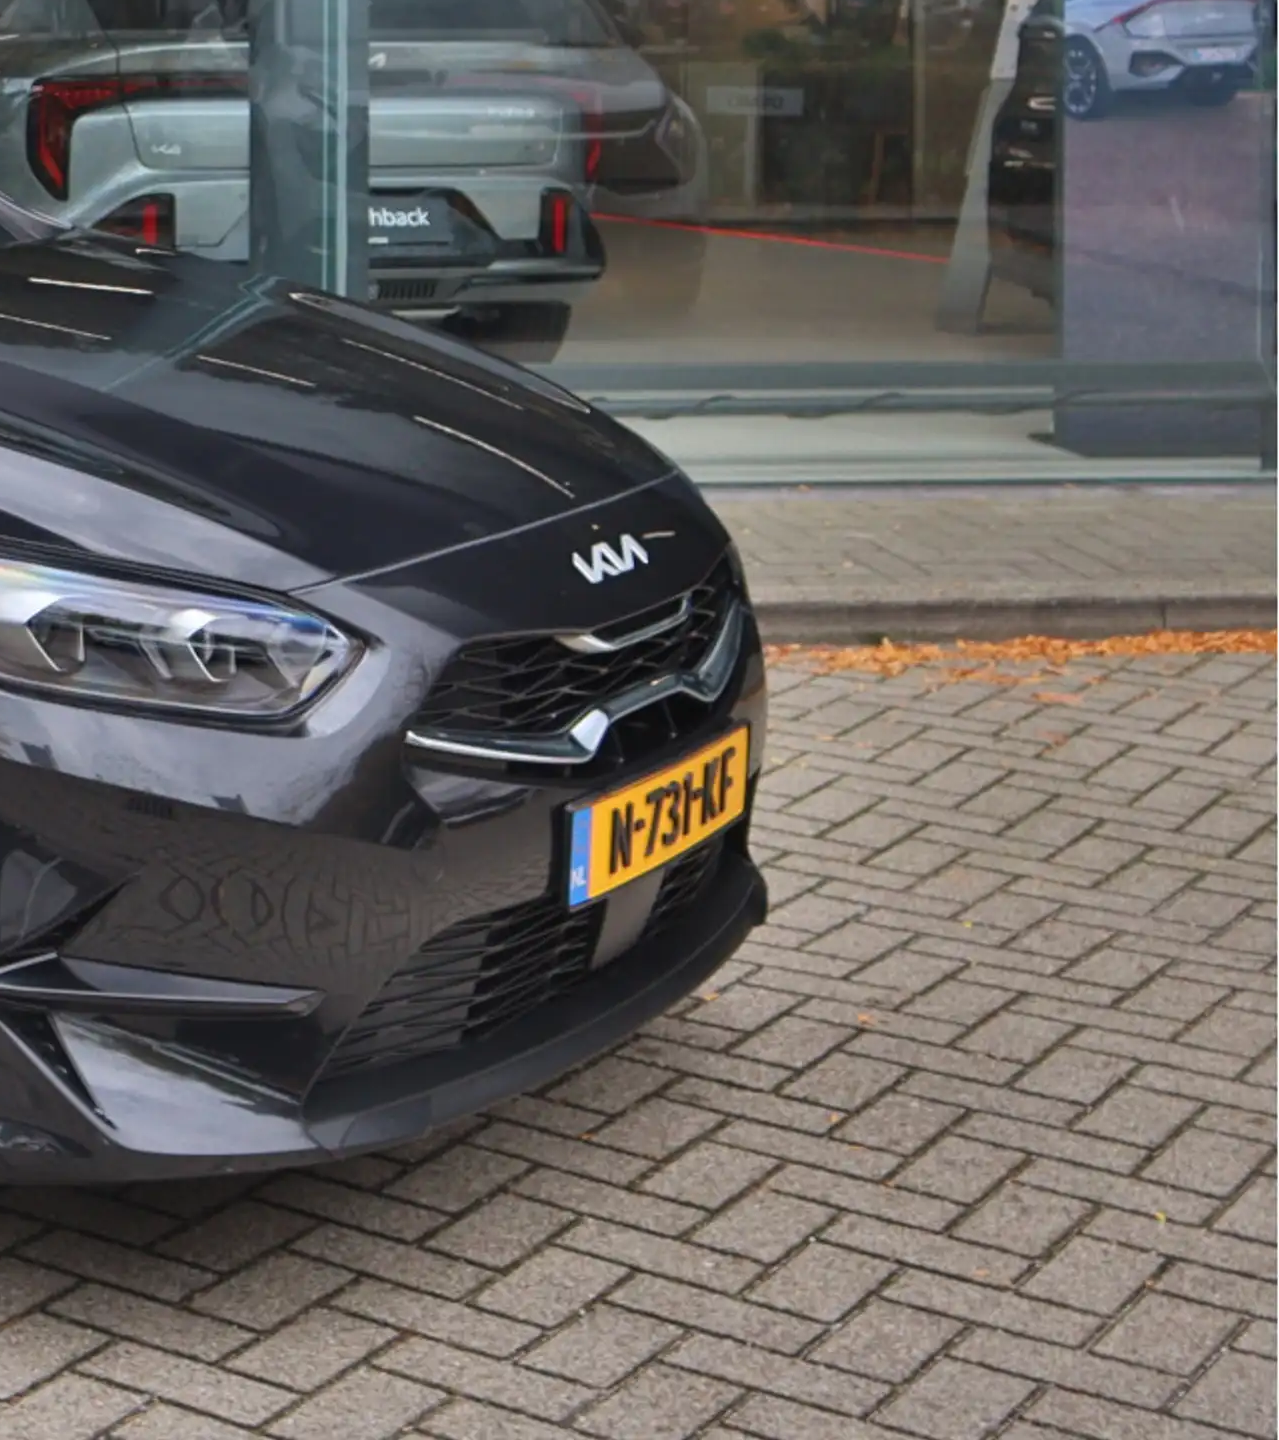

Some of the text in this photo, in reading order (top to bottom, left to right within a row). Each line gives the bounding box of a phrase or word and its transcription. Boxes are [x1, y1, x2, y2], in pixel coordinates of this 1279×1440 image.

[369, 207, 432, 228] hback
[572, 533, 649, 584] KIA
[608, 746, 736, 876] N-731-KF
[570, 867, 588, 891] NL
